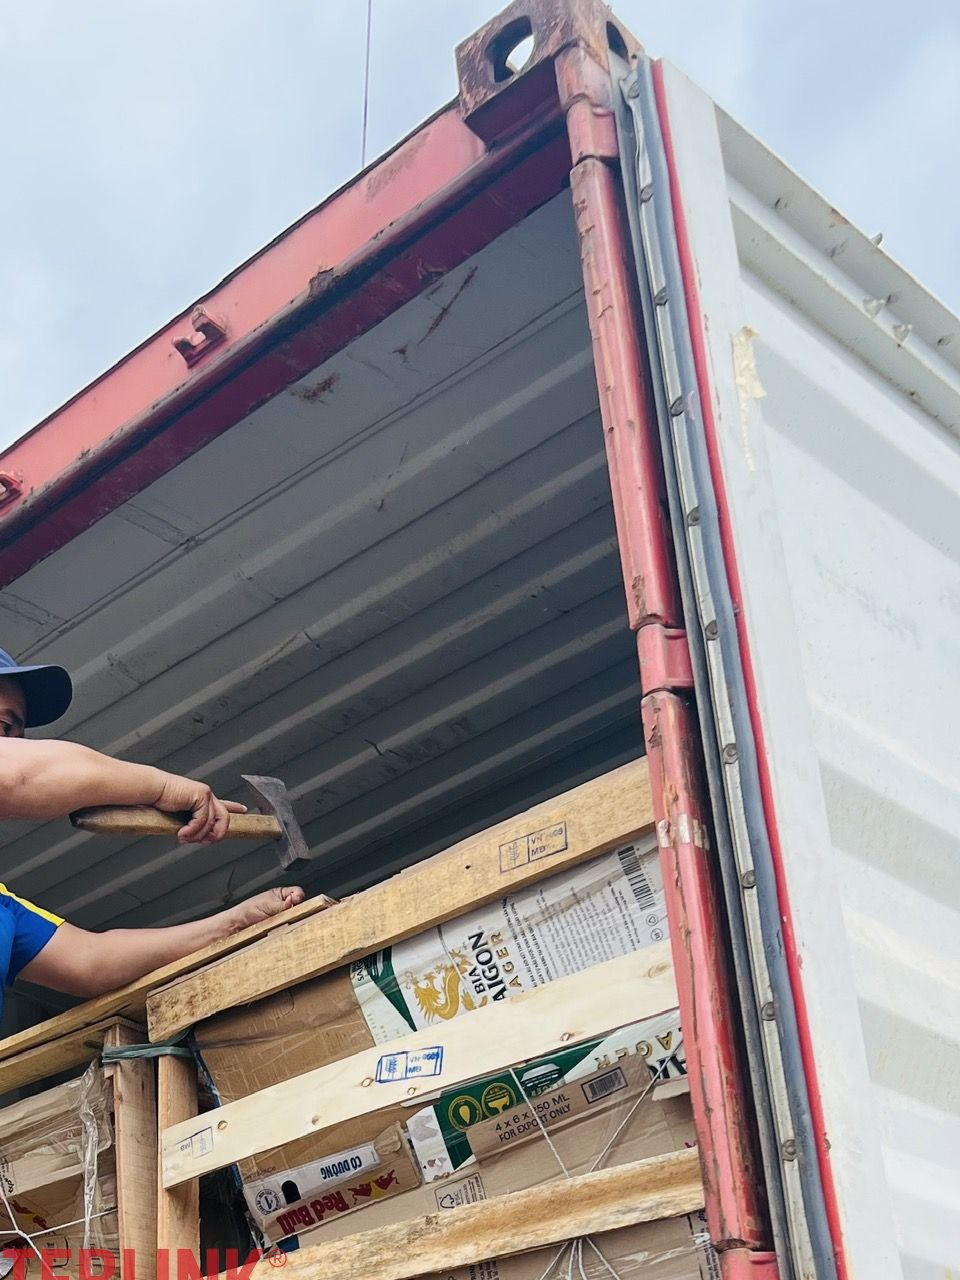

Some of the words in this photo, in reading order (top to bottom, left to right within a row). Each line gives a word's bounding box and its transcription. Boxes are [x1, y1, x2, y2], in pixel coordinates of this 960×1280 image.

[468, 931, 507, 1002] AIGON
[491, 932, 522, 988] AGER
[469, 967, 486, 995] BIA
[594, 1030, 674, 1070] AGER
[493, 1122, 502, 1131] 4
[511, 1114, 520, 1123] 6
[551, 1091, 569, 1105] ML
[498, 1128, 516, 1141] FOR
[548, 1103, 572, 1118] ONLY
[276, 1208, 316, 1235] Bull
[310, 1191, 350, 1222] Red
